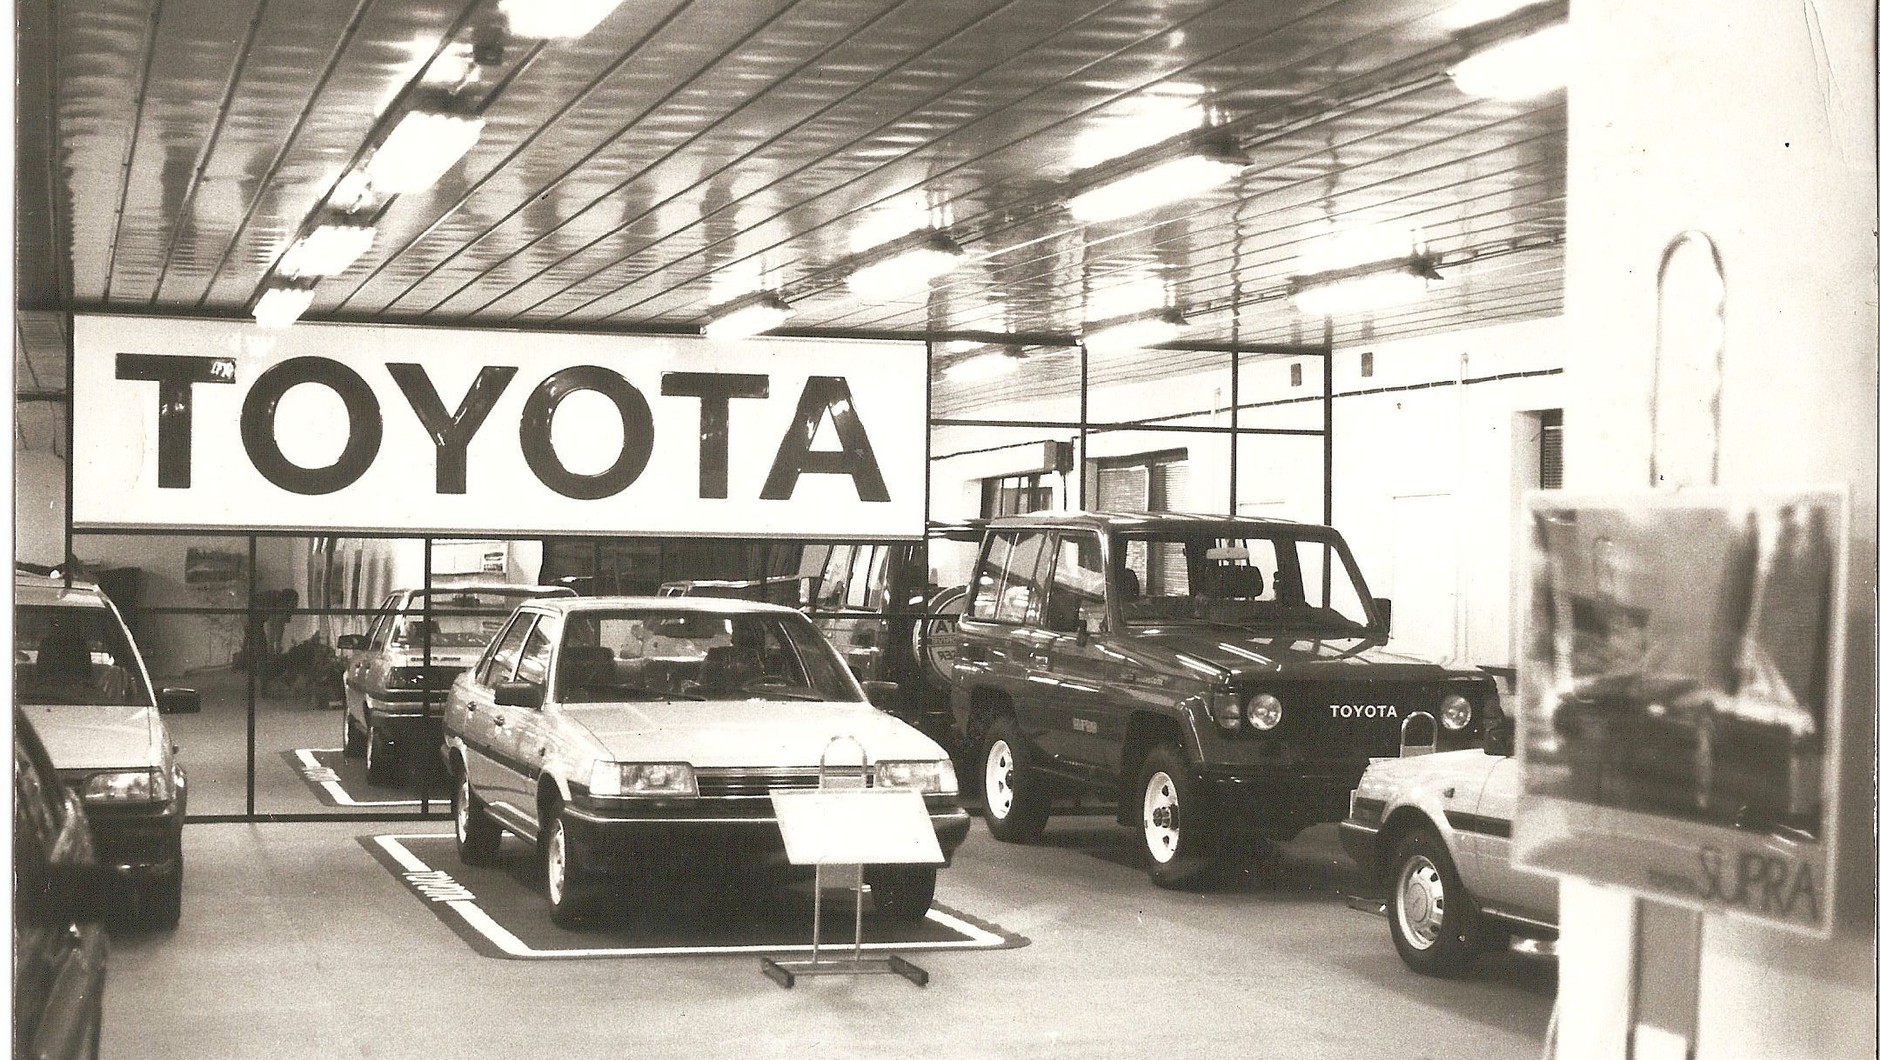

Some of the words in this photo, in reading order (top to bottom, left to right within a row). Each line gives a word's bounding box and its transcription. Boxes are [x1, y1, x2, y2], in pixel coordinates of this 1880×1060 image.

[115, 352, 891, 502] TOYOTA
[1329, 704, 1398, 718] TOYOTA
[1699, 845, 1821, 924] SUPRA
